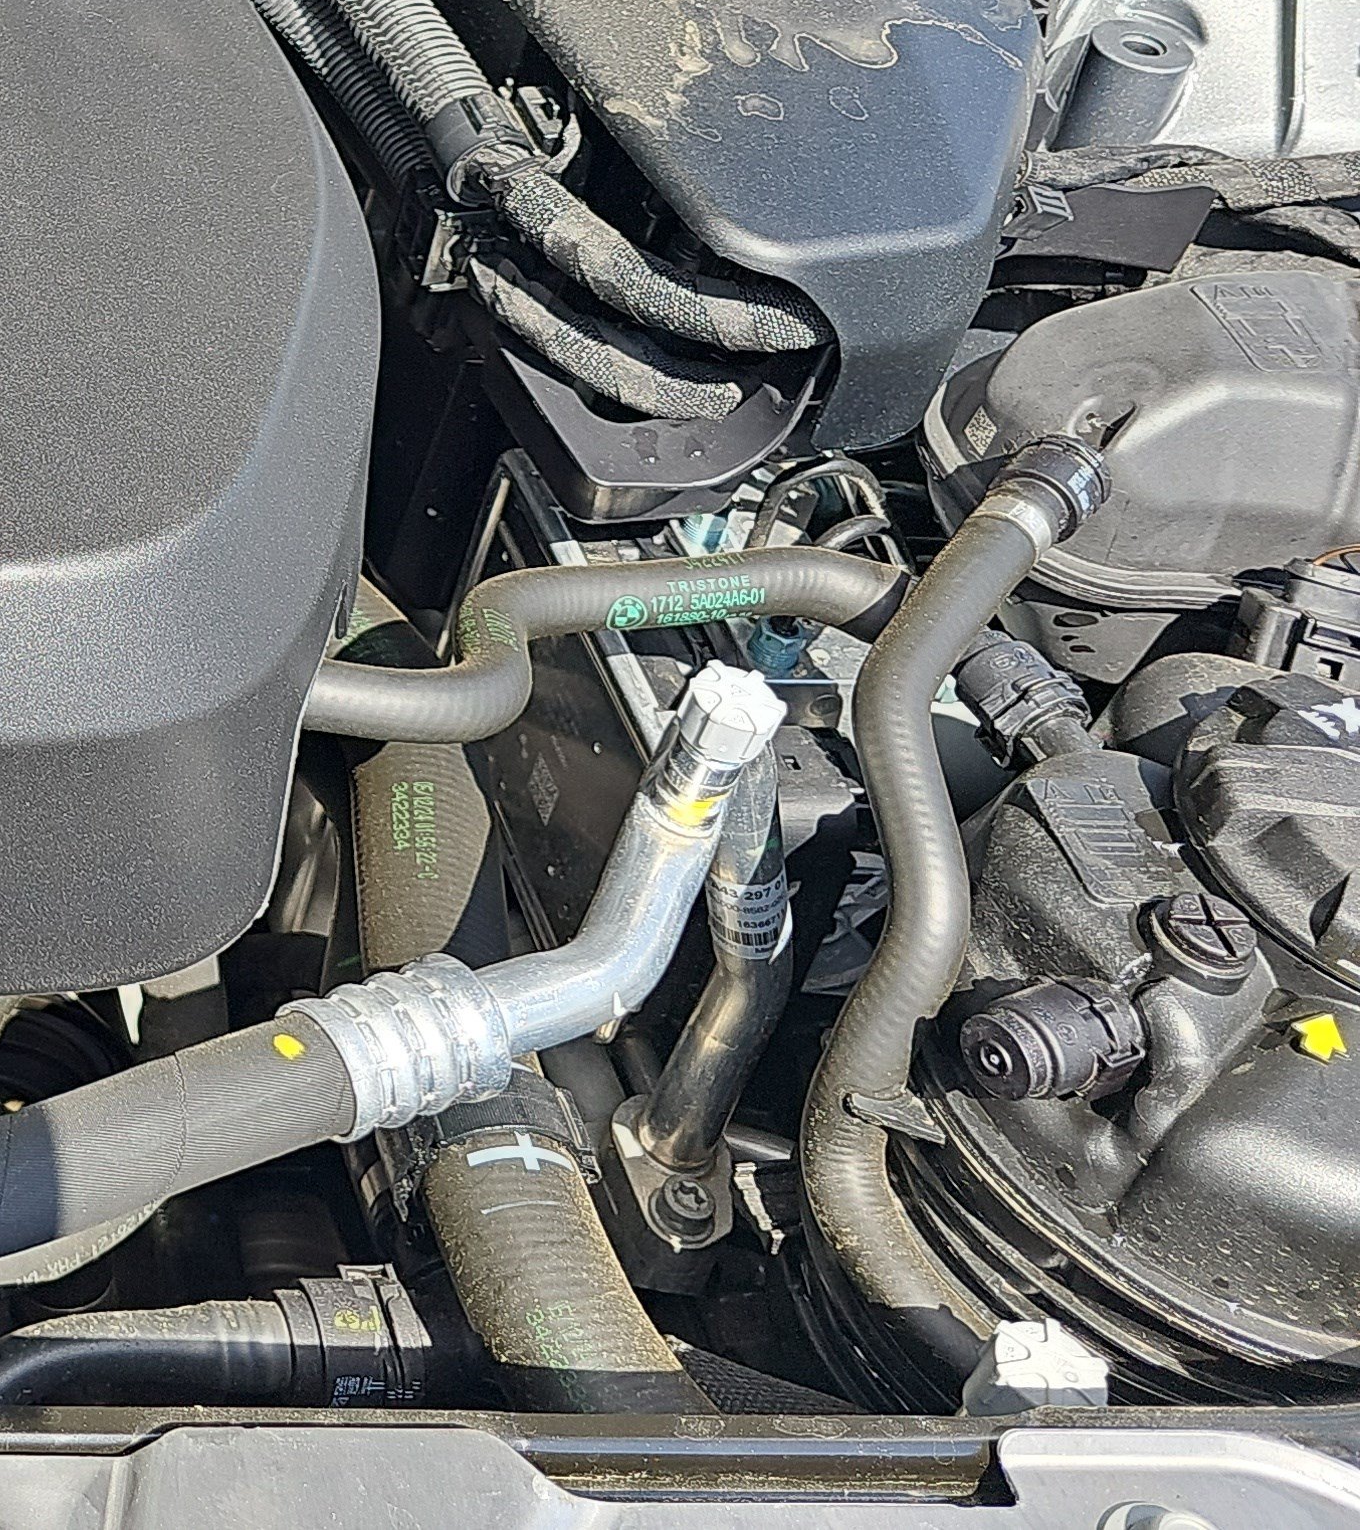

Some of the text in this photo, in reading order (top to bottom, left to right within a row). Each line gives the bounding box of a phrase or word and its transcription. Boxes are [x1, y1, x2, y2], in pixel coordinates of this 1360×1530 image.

[667, 575, 750, 594] TRISTONE
[650, 594, 684, 613] 1712
[390, 781, 411, 851] 3422334
[743, 886, 771, 901] 297
